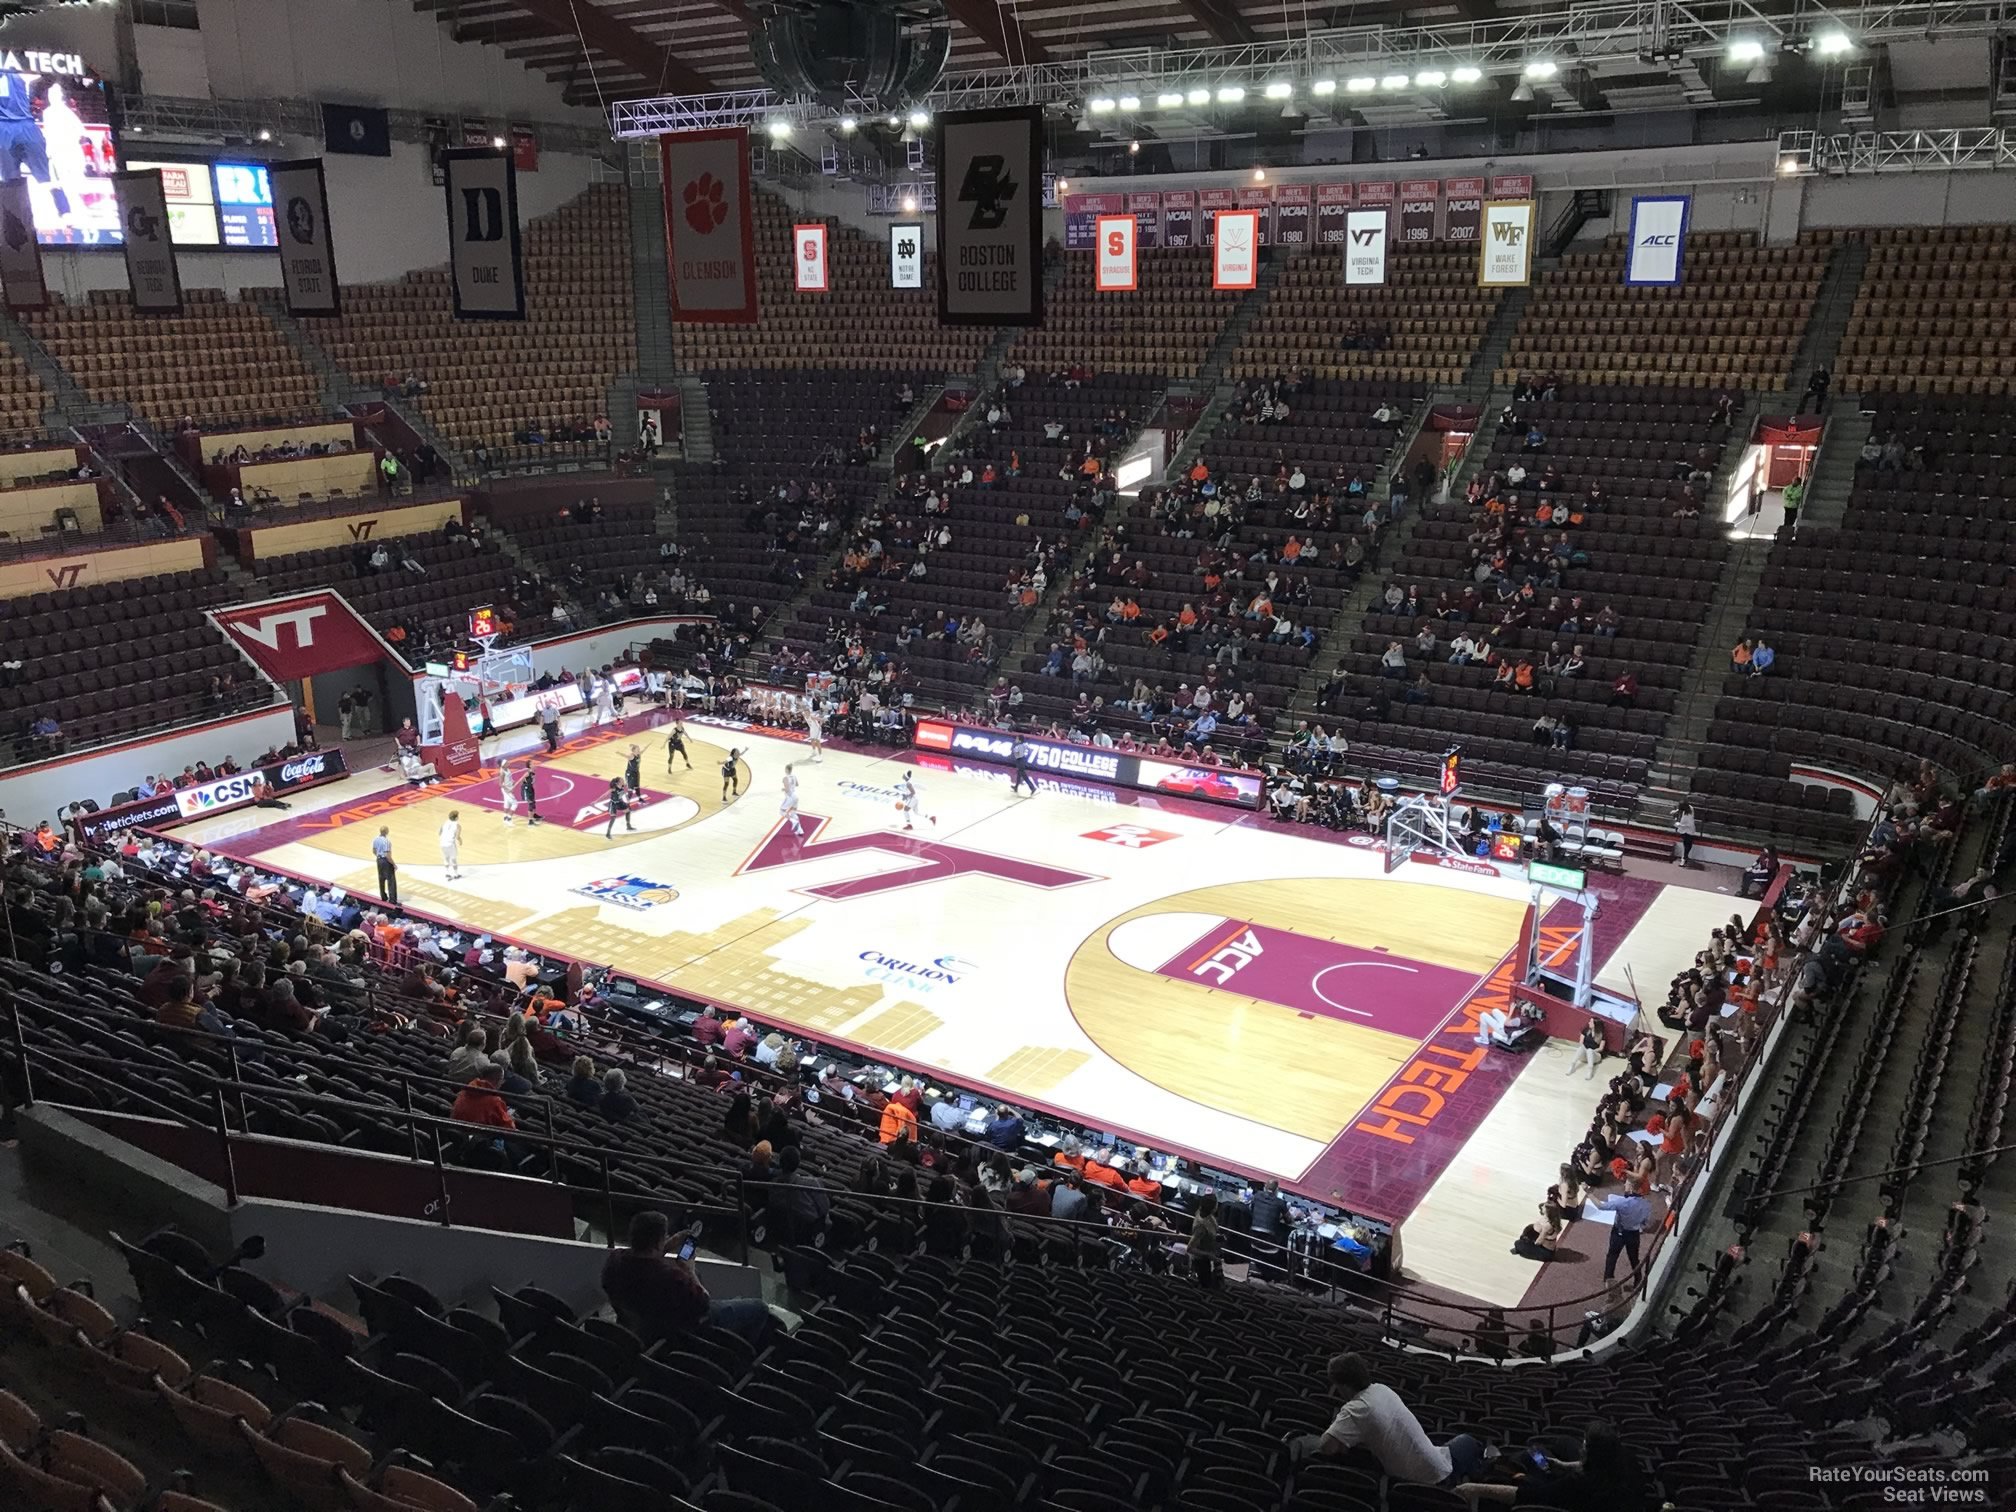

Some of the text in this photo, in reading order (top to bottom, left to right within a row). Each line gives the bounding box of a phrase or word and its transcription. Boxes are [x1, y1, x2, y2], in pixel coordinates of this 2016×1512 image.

[24, 51, 84, 75] TECH
[1495, 185, 1528, 194] BASKETBALL
[1503, 179, 1521, 187] MEN'S
[1279, 205, 1307, 217] NCAA
[1403, 202, 1434, 214] NCAA
[1448, 200, 1480, 212] NCAA
[1166, 210, 1192, 221] NCAA
[1202, 209, 1215, 220] NC
[1282, 231, 1303, 242] 1980
[1323, 230, 1344, 241] 1985
[1350, 228, 1383, 246] VT
[1407, 228, 1428, 240] 1996
[1451, 226, 1474, 239] 2007
[1492, 222, 1524, 246] WF
[1108, 232, 1124, 255] S
[1169, 234, 1188, 246] 1967
[1206, 234, 1215, 245] 19
[1641, 235, 1676, 245] ACC
[960, 244, 1015, 266] BOSTON
[1351, 257, 1380, 266] VIRGINIA
[1495, 254, 1516, 263] WAKE
[291, 259, 322, 274] FLORIDA
[683, 259, 737, 280] CLEMSON
[1102, 265, 1130, 274] SYRACUSE
[1222, 263, 1248, 272] VIRGINIA
[1357, 267, 1374, 276] TECH
[1491, 264, 1518, 273] FOREST
[472, 266, 499, 284] DUKE
[958, 270, 1017, 292] COLLEGE
[297, 278, 322, 292] STATE
[347, 520, 378, 541] VT
[46, 563, 88, 588] VT
[228, 604, 328, 652] VT
[475, 620, 491, 635] 26
[535, 691, 567, 711] dish
[1060, 750, 1118, 771] COLLEGE
[1502, 835, 1520, 846] 7:39
[1499, 844, 1514, 858] 26
[1193, 929, 1264, 985] ACC
[859, 950, 960, 984] CARILION
[1355, 1045, 1488, 1145] TECH
